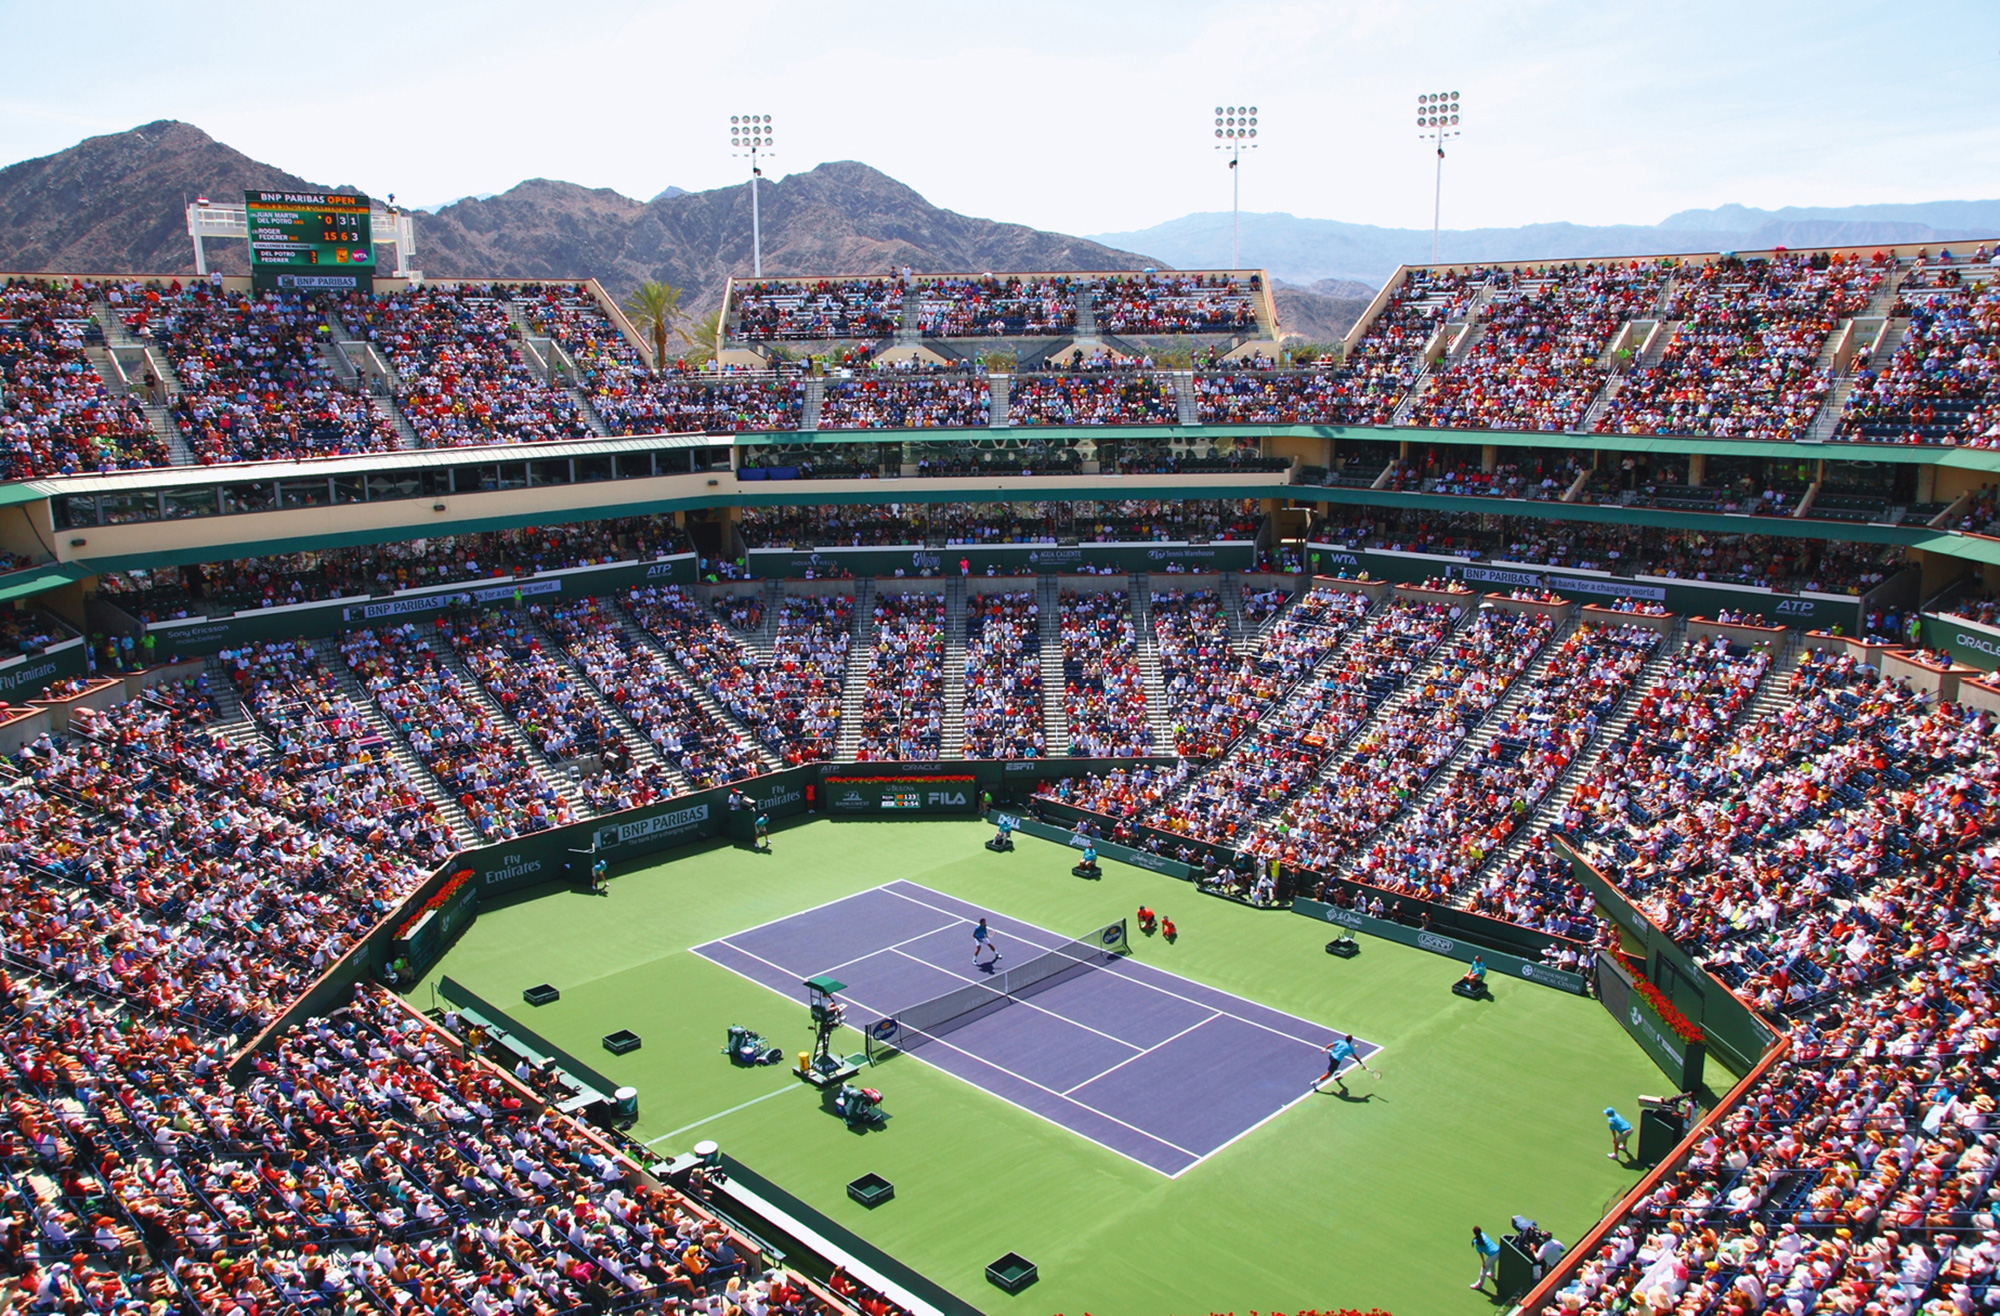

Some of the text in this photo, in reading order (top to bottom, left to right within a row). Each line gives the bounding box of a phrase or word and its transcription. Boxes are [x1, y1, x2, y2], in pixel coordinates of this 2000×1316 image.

[260, 193, 355, 205] BNP PARIBAS OPEN
[324, 215, 332, 224] 0
[340, 216, 346, 226] 3
[350, 216, 357, 226] 1
[324, 232, 338, 241] 15
[340, 232, 348, 241] 6
[351, 232, 358, 242] 3
[297, 277, 354, 286] BNP PARIBAS
[1331, 554, 1358, 565] WTA
[647, 564, 672, 576] ATP
[1466, 568, 1486, 579] BNP
[1490, 570, 1530, 584] PARIBAS
[1559, 580, 1575, 588] bank
[1578, 582, 1588, 590] for
[1596, 582, 1630, 594] changing
[1632, 588, 1655, 597] world
[368, 604, 390, 616] BNP
[394, 598, 438, 612] PARIBAS
[484, 590, 495, 600] for
[534, 582, 552, 591] world
[1776, 600, 1814, 612] ATP
[168, 624, 229, 638] Sony Ericsson
[15, 662, 57, 684] Emirates
[1005, 762, 1034, 771] ESPN
[772, 785, 785, 794] Fly
[758, 791, 800, 810] Emirates
[928, 792, 967, 805] FILA
[622, 806, 704, 838] BNP PARIBAS
[638, 836, 650, 844] bank
[662, 828, 684, 836] changing
[504, 854, 520, 865] Fly
[485, 860, 542, 884] Emirates
[1420, 934, 1450, 949] USANA
[1532, 972, 1580, 990] MEDICAL CENTER
[1534, 967, 1569, 982] EISENHOWER
